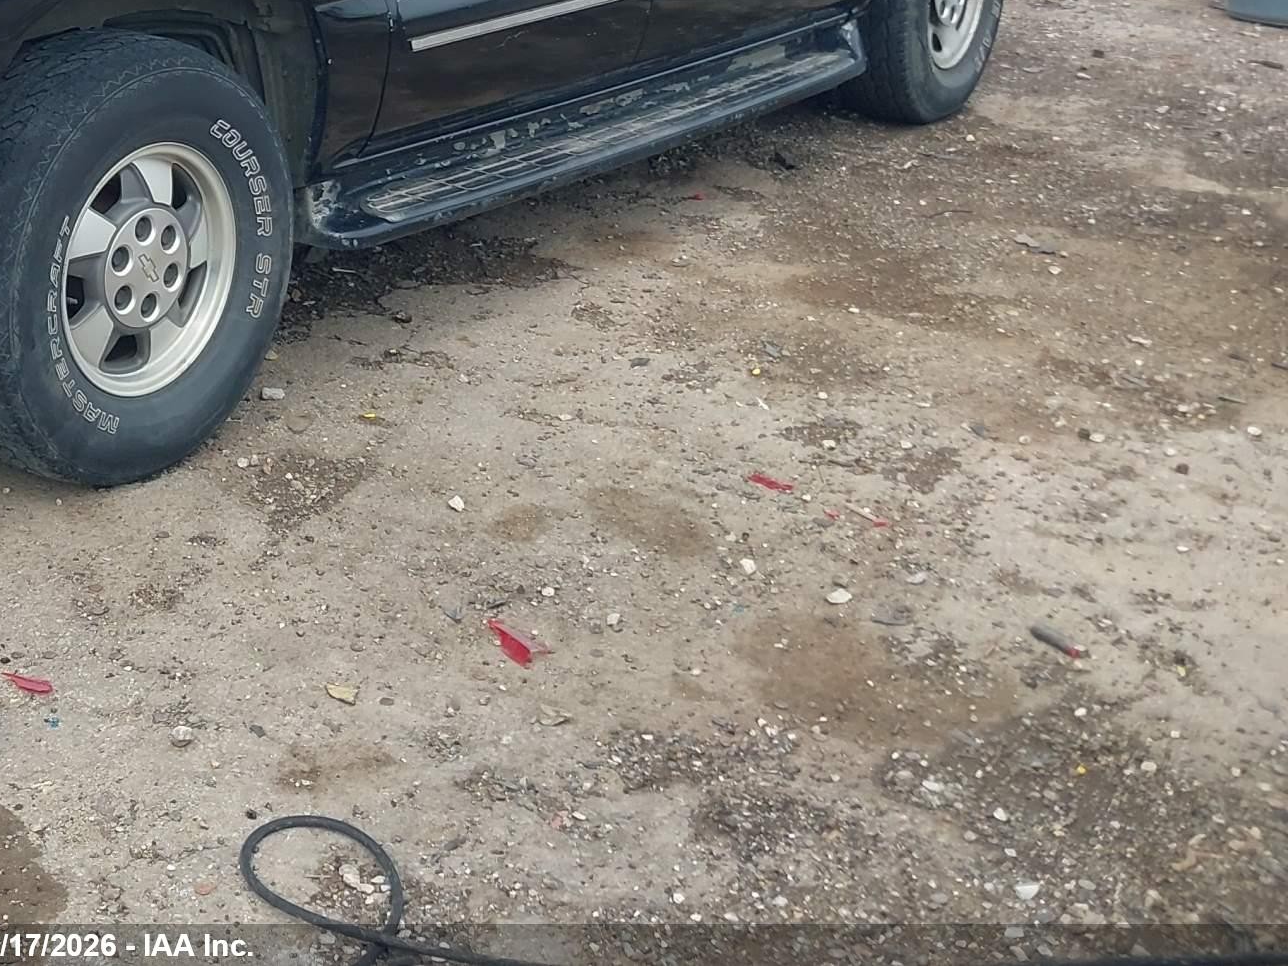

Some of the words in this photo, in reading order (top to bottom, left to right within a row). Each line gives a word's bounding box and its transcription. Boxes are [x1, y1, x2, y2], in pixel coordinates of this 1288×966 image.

[45, 214, 122, 436] MASTERCRAFT
[209, 118, 274, 238] COURSER
[244, 253, 272, 320] STR
